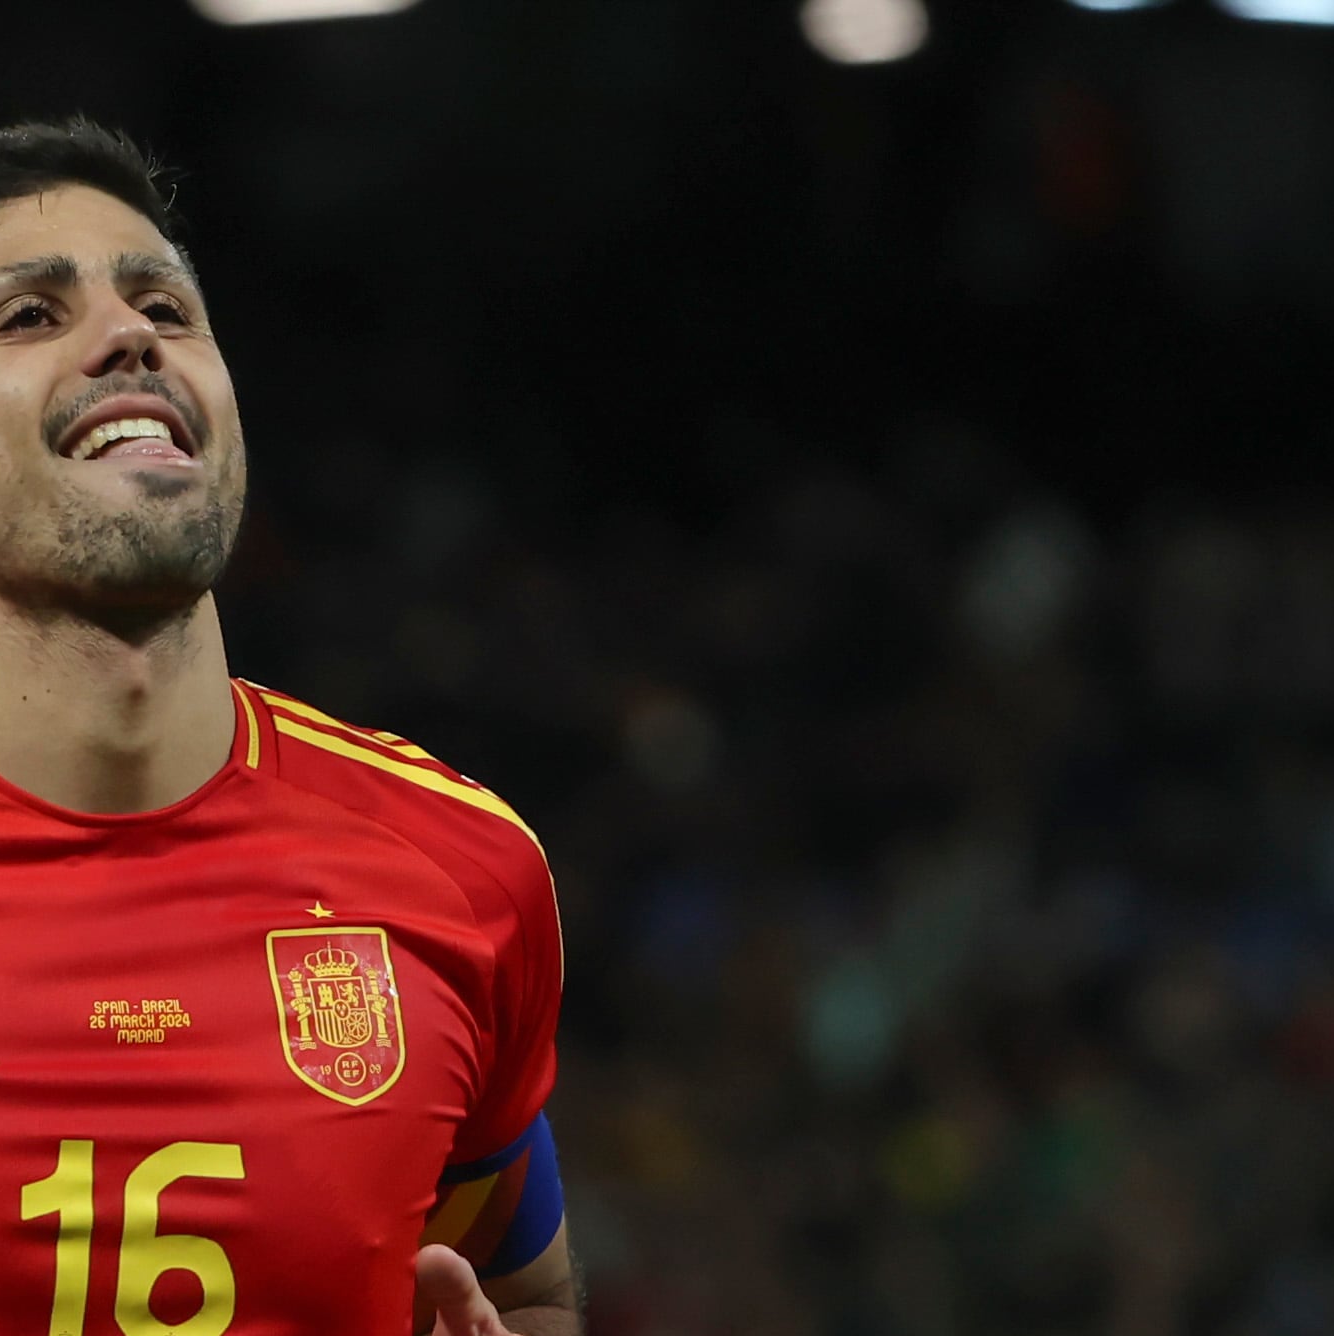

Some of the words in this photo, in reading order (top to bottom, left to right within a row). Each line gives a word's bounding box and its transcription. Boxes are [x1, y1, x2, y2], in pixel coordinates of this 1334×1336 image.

[93, 1000, 130, 1014] SPAIN
[141, 999, 184, 1014] BRAZIL
[89, 1015, 106, 1029] 26
[110, 1014, 155, 1029] MARCH
[158, 1013, 191, 1028] 2024
[117, 1029, 165, 1044] MADRID
[320, 1064, 332, 1075] 19
